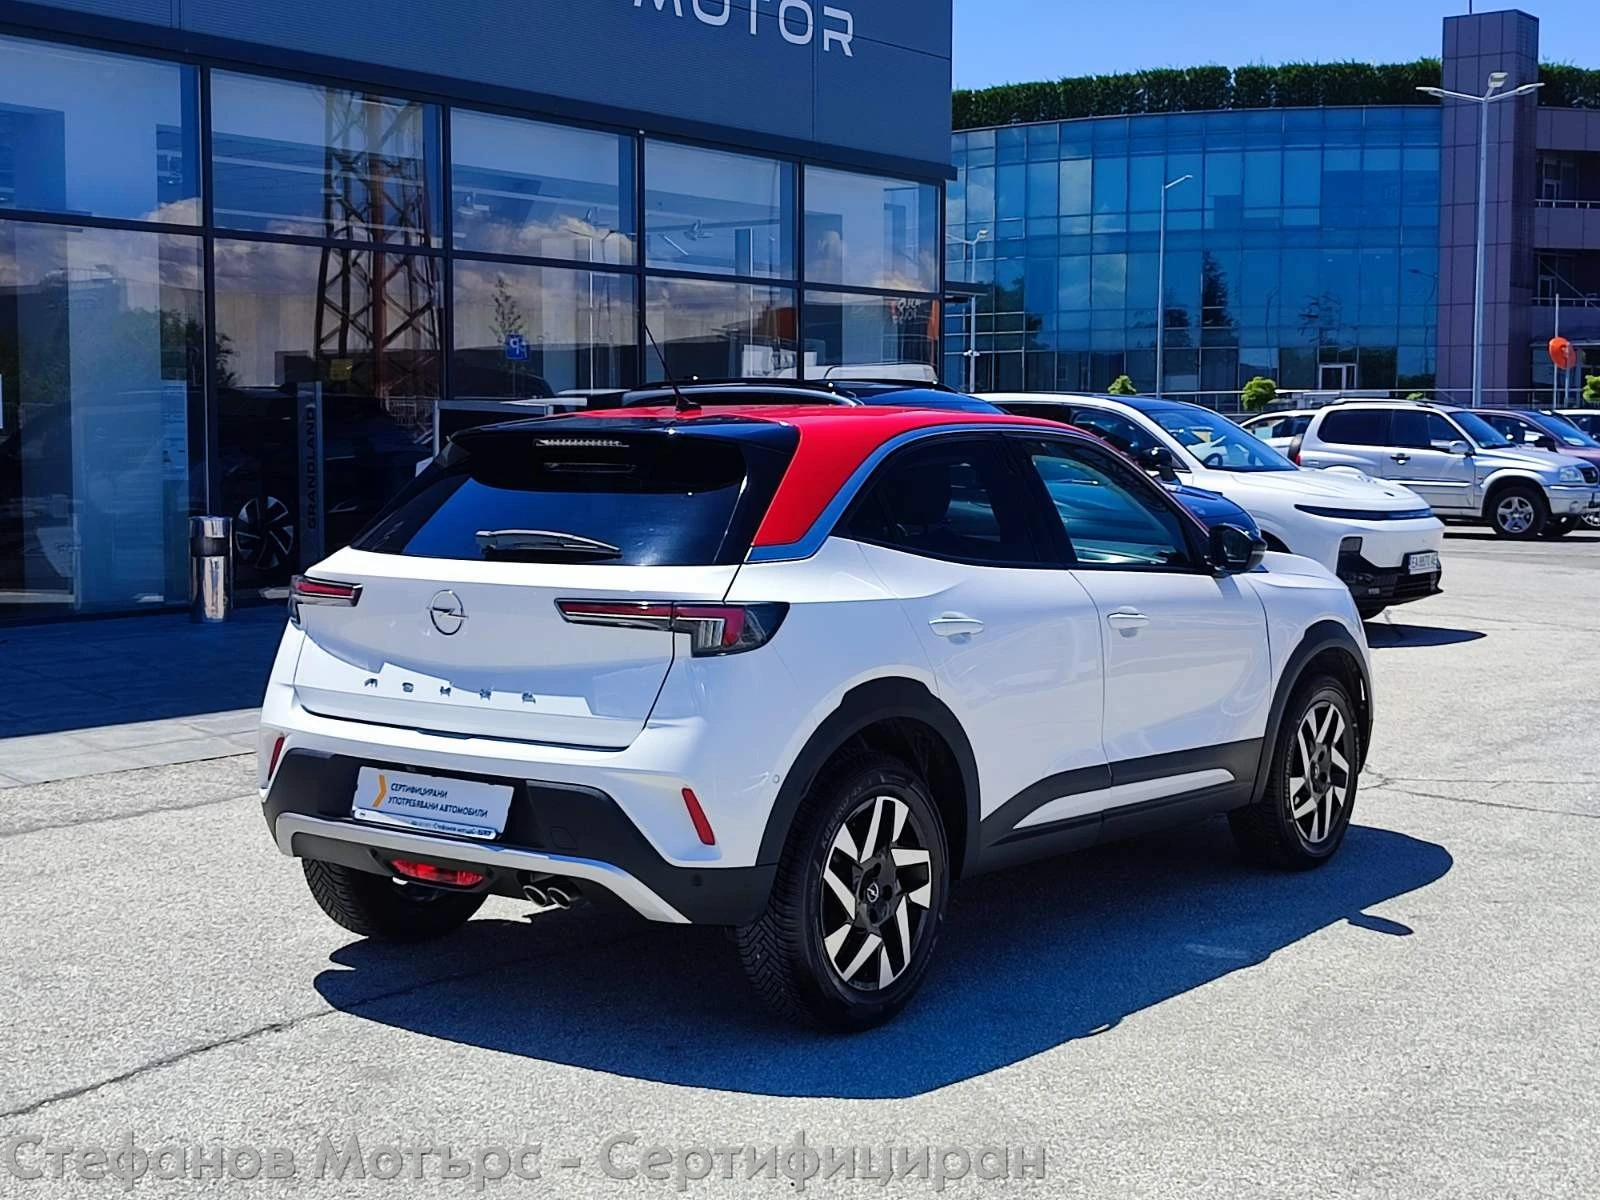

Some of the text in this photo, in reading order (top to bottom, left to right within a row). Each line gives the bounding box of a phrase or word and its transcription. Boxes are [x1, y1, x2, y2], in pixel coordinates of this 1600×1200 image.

[306, 407, 317, 530] GRANDLAND
[390, 782, 448, 799] СЕРТИФИЦИРАНИ
[388, 796, 489, 818] УПОТРЕБЯВАНИ АВТОМОБИЛИ
